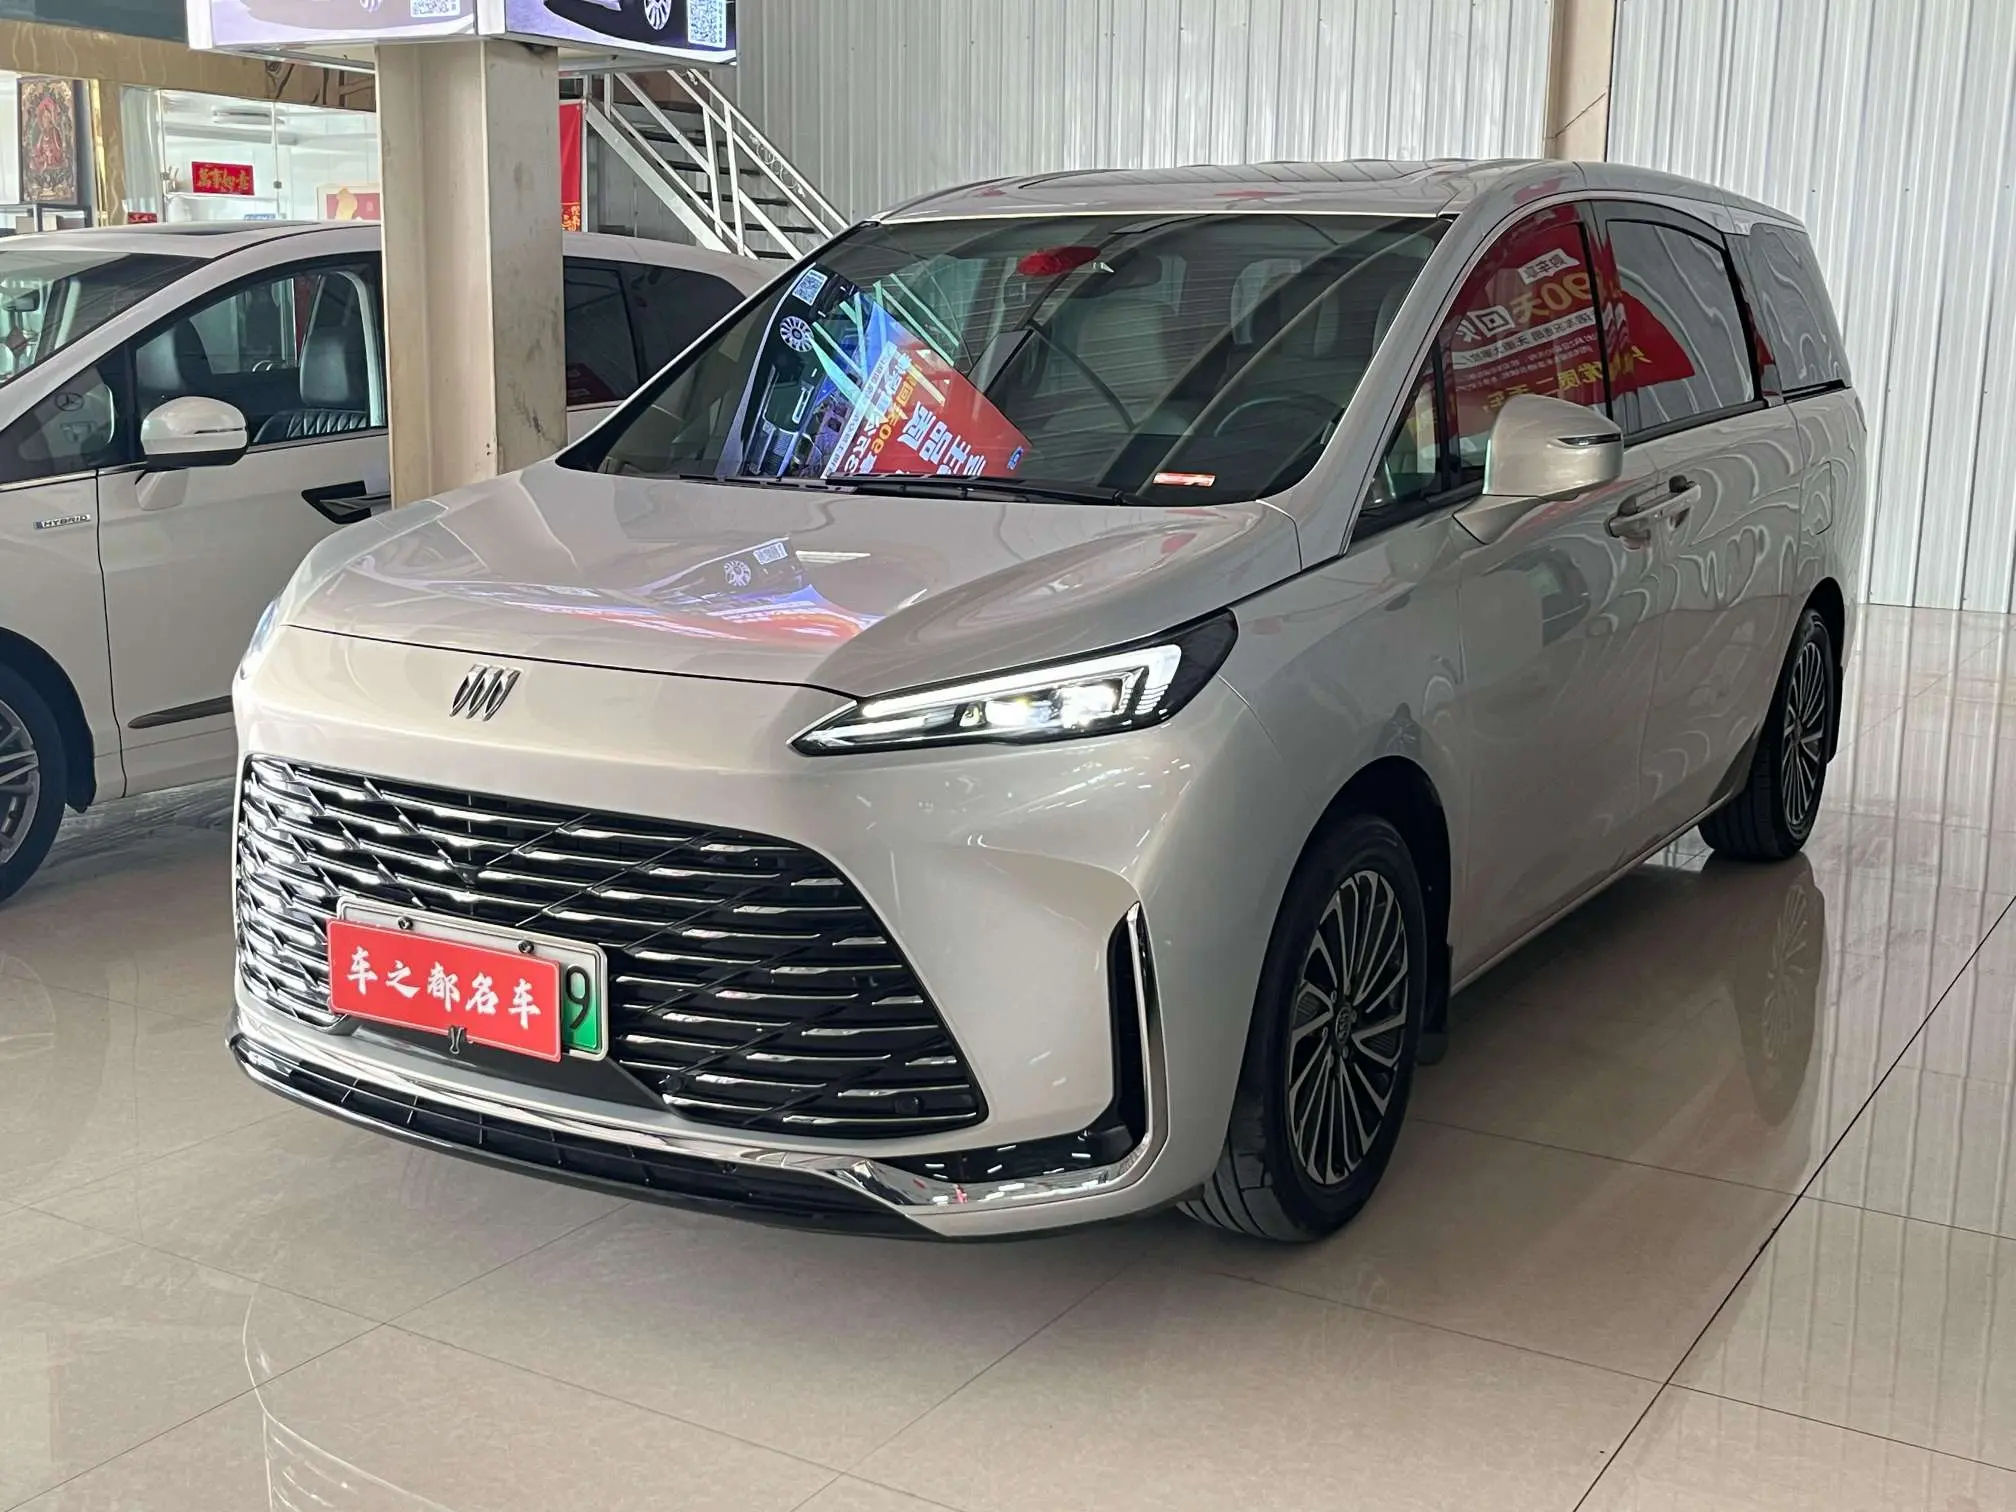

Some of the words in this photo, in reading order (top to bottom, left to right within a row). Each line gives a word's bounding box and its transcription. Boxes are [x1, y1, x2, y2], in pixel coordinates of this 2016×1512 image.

[44, 514, 90, 528] HYBRID
[346, 945, 542, 1031] 车之都名车
[565, 964, 592, 1031] 9
